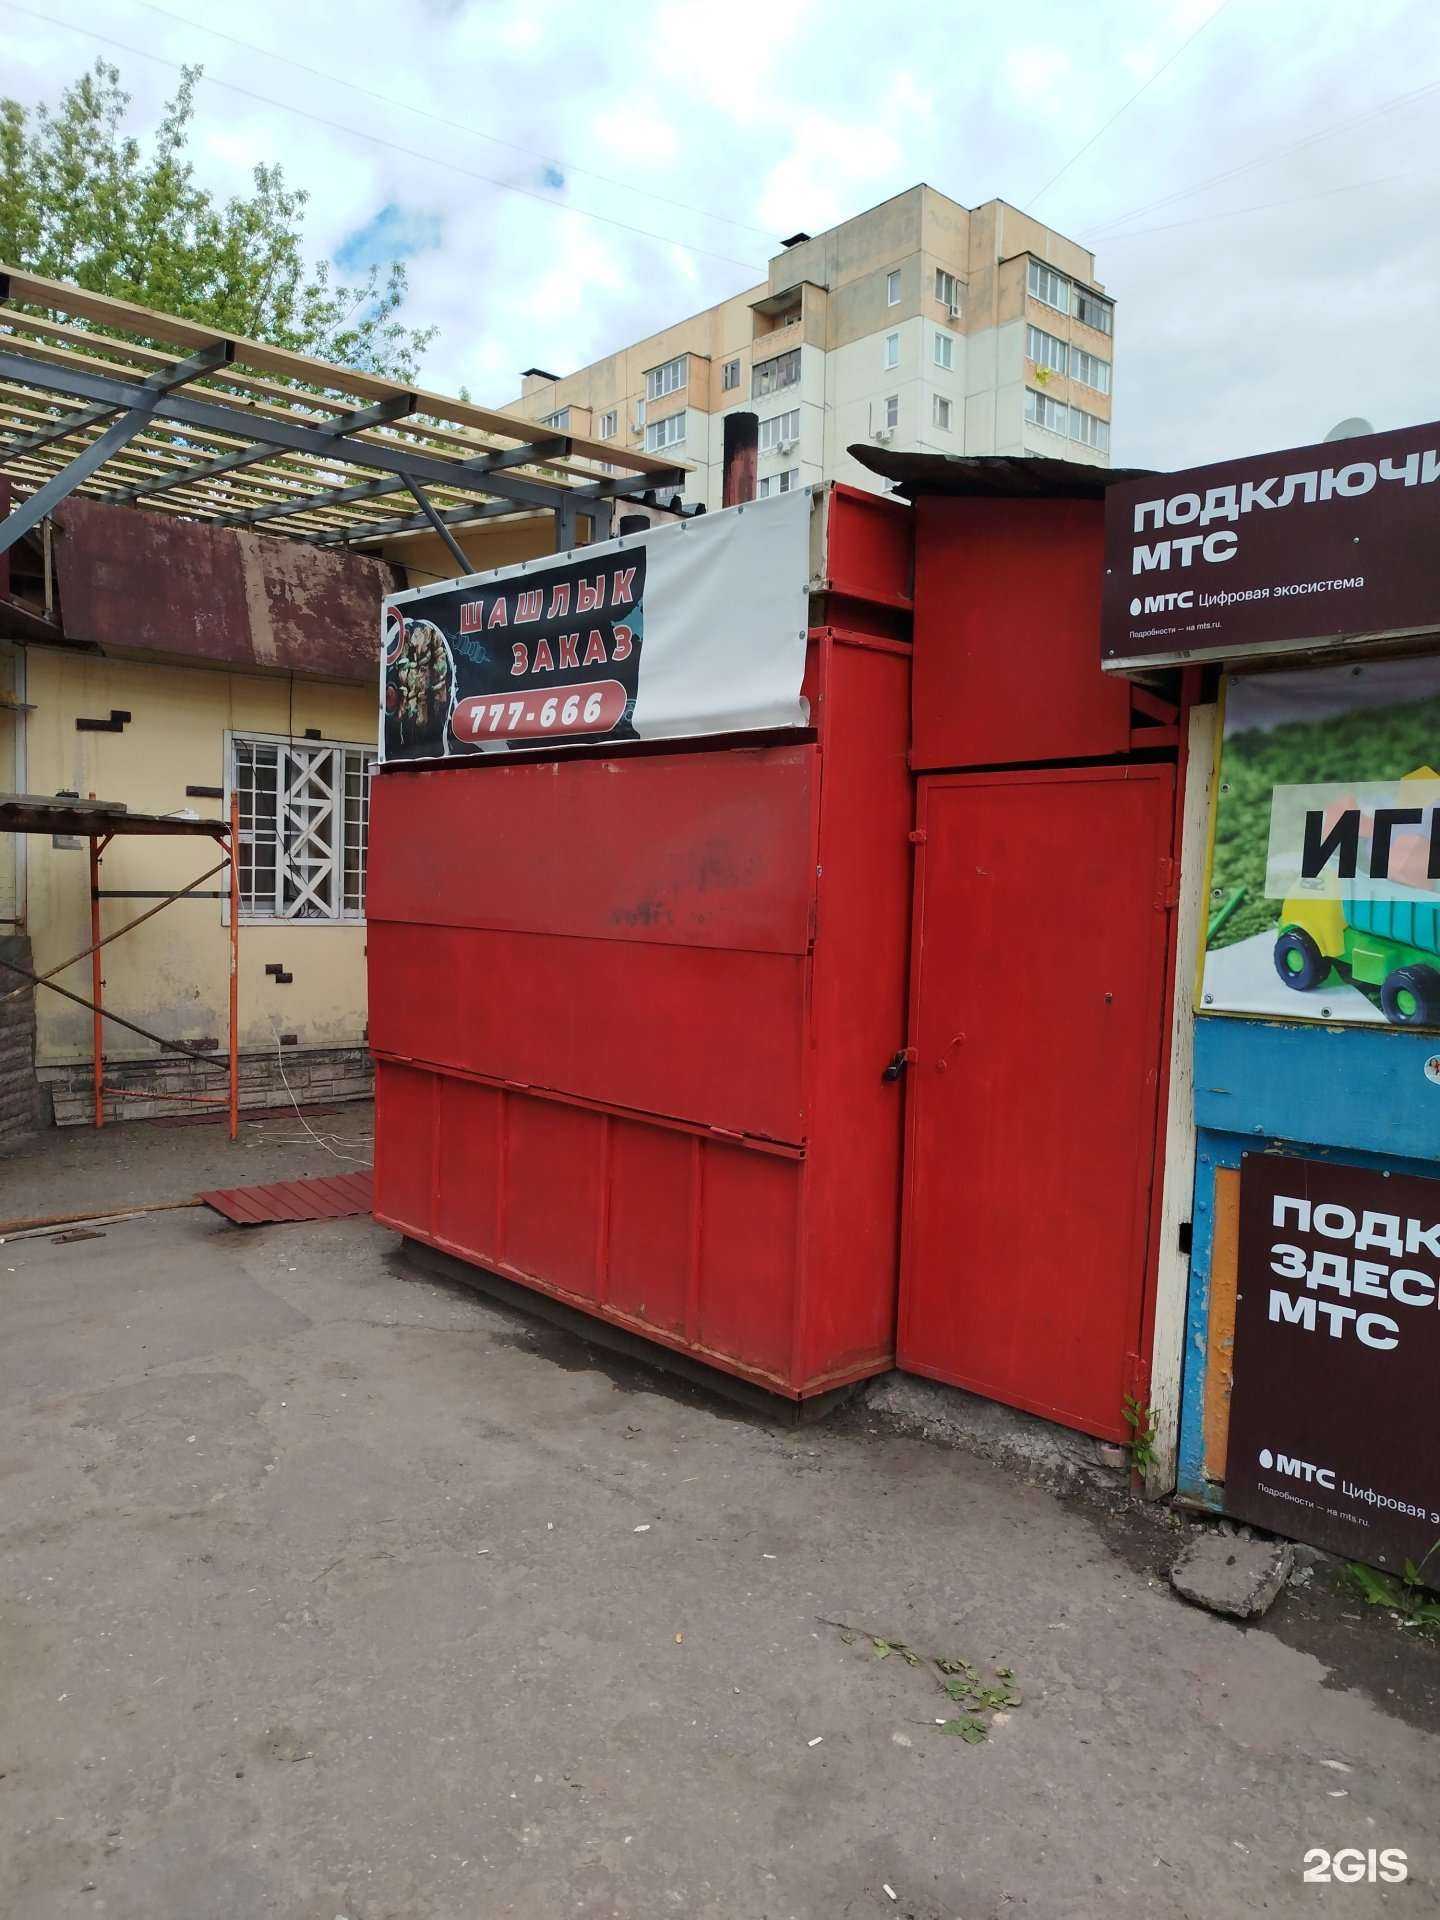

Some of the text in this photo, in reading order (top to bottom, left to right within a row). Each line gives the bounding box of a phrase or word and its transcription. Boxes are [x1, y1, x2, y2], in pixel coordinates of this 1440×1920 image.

[1132, 530, 1238, 575] МТС
[459, 567, 637, 634] ШАШЛЫК
[1144, 576, 1364, 614] МТС Цифровая экосистема
[510, 625, 633, 676] ЗАКАЗ
[1129, 626, 1176, 639] Подробности
[469, 693, 603, 734] 777-666
[1301, 807, 1440, 879] ИГ
[1270, 1243, 1440, 1311] ЗДЕС
[1268, 1289, 1400, 1350] МТС
[1258, 1482, 1314, 1509] Подробности
[1276, 1454, 1335, 1490] МТС
[1342, 1480, 1426, 1520] Цифровая
